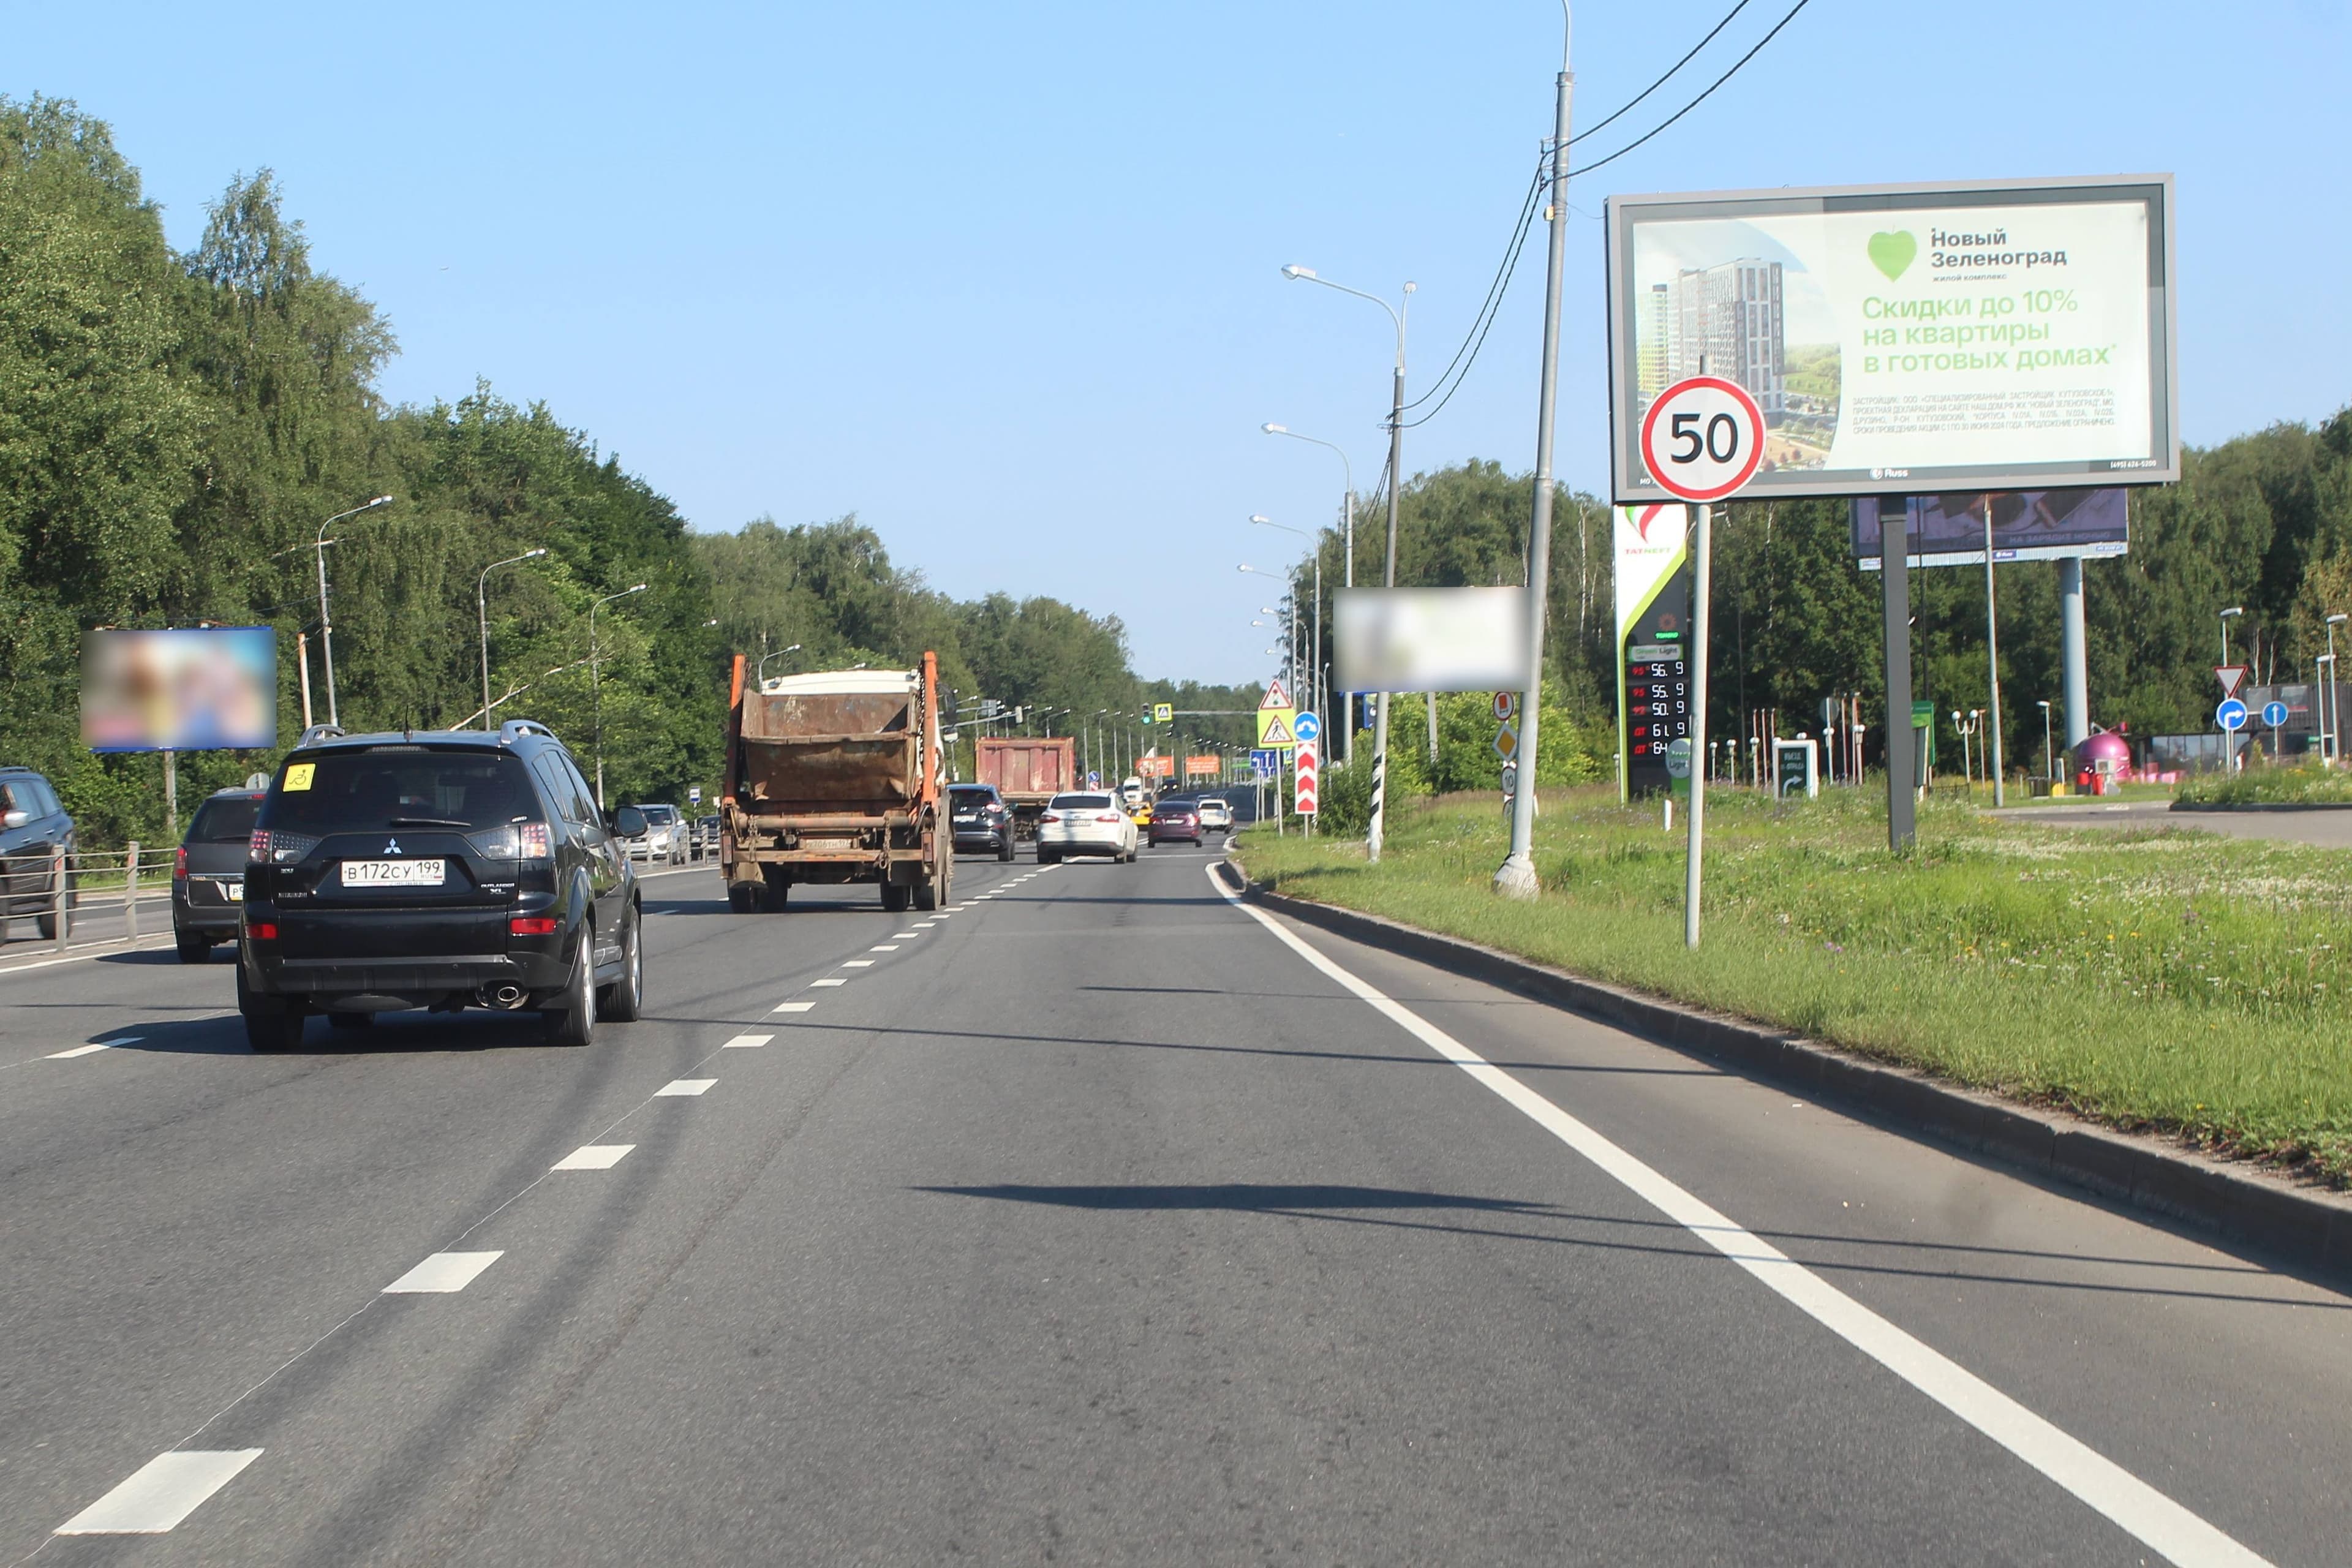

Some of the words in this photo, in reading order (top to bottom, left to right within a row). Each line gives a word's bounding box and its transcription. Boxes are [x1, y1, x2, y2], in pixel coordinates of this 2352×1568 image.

[1931, 228, 2007, 247] Новый
[1931, 249, 2068, 268] Зеленоград
[1932, 274, 1962, 282] жилой
[1964, 273, 2007, 282] комплекс
[1862, 296, 1972, 321] Скидки
[1979, 296, 2015, 318] до
[2022, 288, 2078, 314] 10%
[1863, 328, 1897, 346] на
[1906, 321, 2049, 349] квартиры
[1864, 355, 1880, 373] в
[1888, 351, 2009, 373] готовых
[1853, 407, 1891, 415] ПРОЕКТНАЯ
[1893, 405, 1937, 415] ДЕКЛАРАЦИЯ
[1948, 402, 1970, 412] САЙТЕ
[1903, 395, 1918, 404] ООО
[1853, 426, 1874, 435] СРОКИ
[1875, 424, 1917, 434] ПРОВЕДЕНИЯ
[1918, 423, 1940, 432] АКЦИИ
[1940, 423, 1947, 432] С
[1950, 423, 1961, 431] ПО
[1970, 421, 1989, 431] ИЮНЯ
[2024, 418, 2072, 429] ПРЕДЛОЖЕНИЕ
[1670, 412, 1738, 464] 50
[1884, 468, 1909, 478] Russ
[1659, 646, 1678, 655] Light
